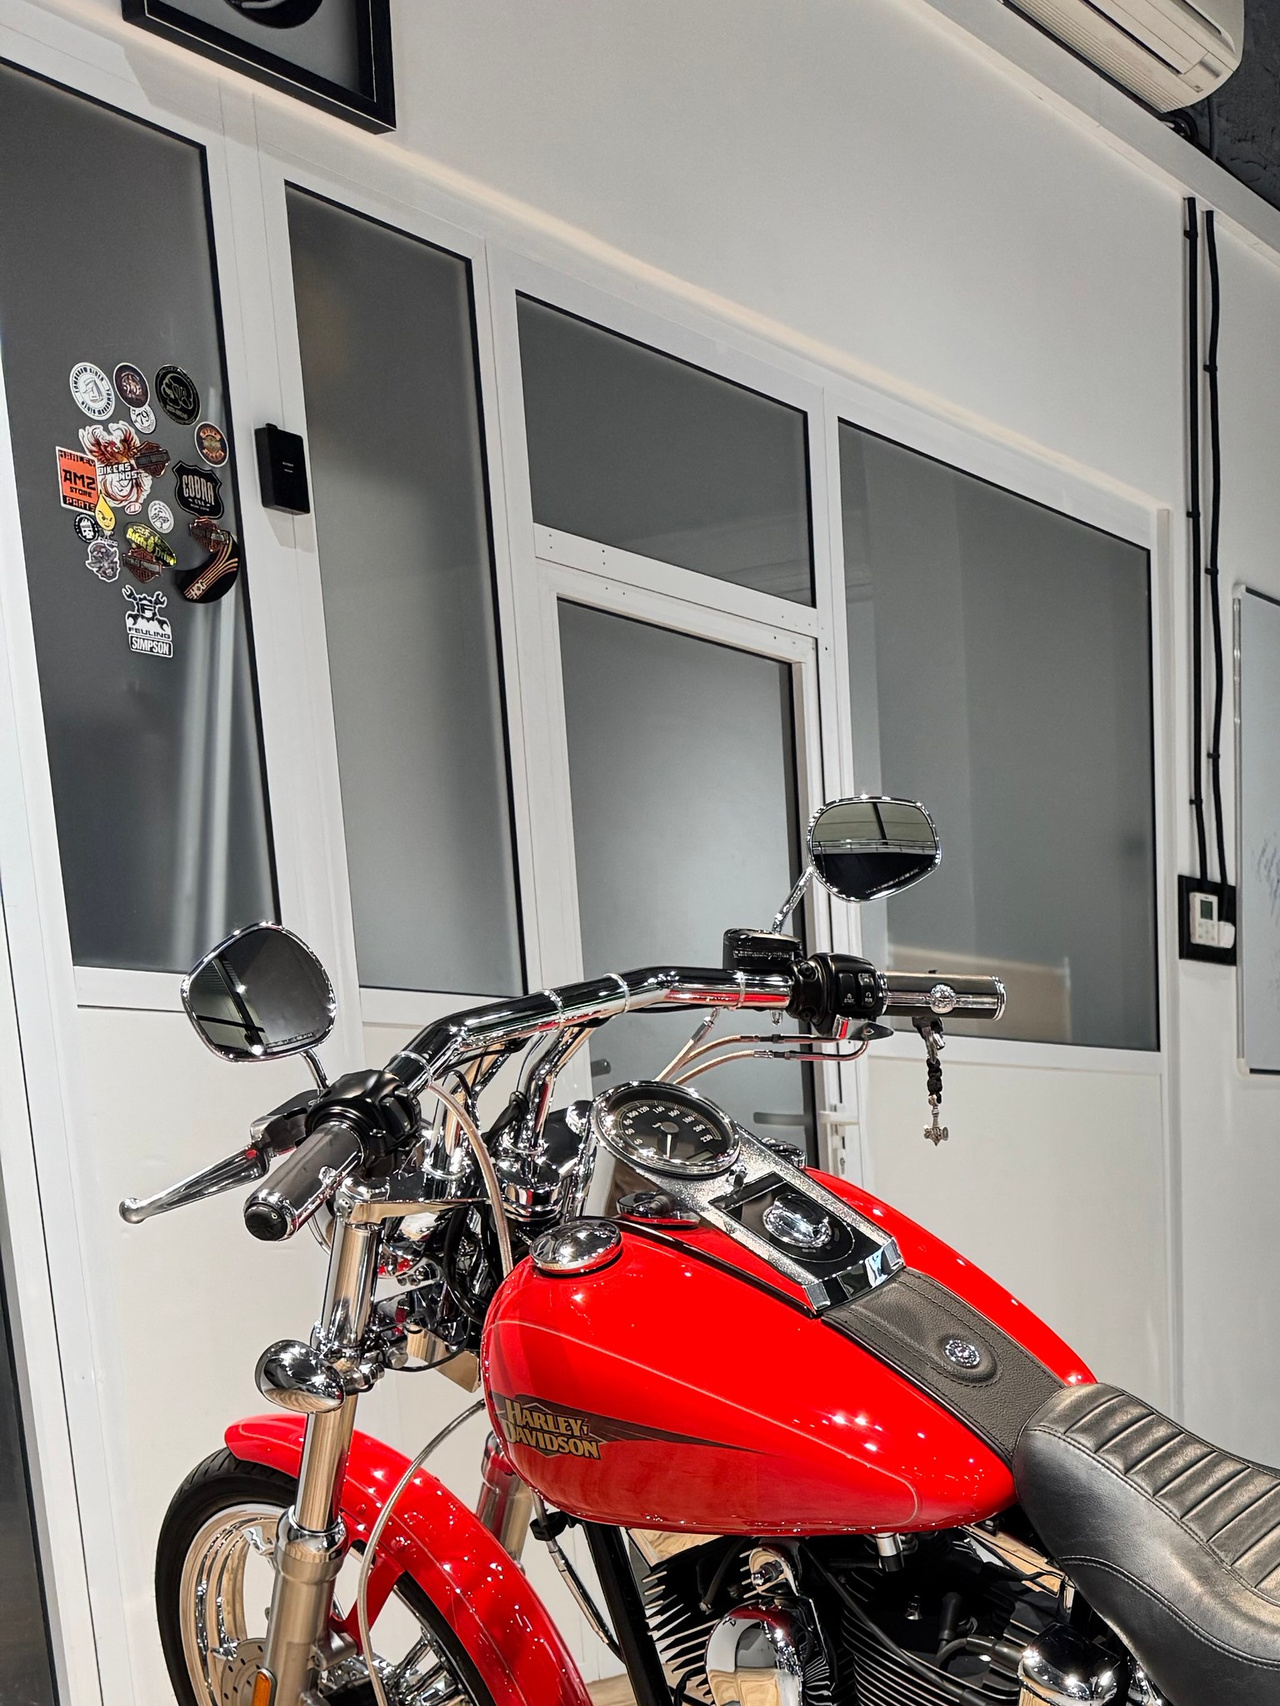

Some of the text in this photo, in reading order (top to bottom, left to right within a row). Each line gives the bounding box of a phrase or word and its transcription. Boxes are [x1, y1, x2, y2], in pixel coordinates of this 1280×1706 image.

[136, 410, 149, 425] 79
[70, 486, 92, 498] STORE
[182, 474, 215, 505] COBRA
[128, 627, 170, 639] FEULING
[132, 637, 170, 655] SIMPSON
[637, 1106, 650, 1114] 120
[652, 1106, 665, 1114] 140
[668, 1109, 680, 1118] 160
[700, 1134, 713, 1143] 220
[501, 1417, 600, 1459] DAVIDSON
